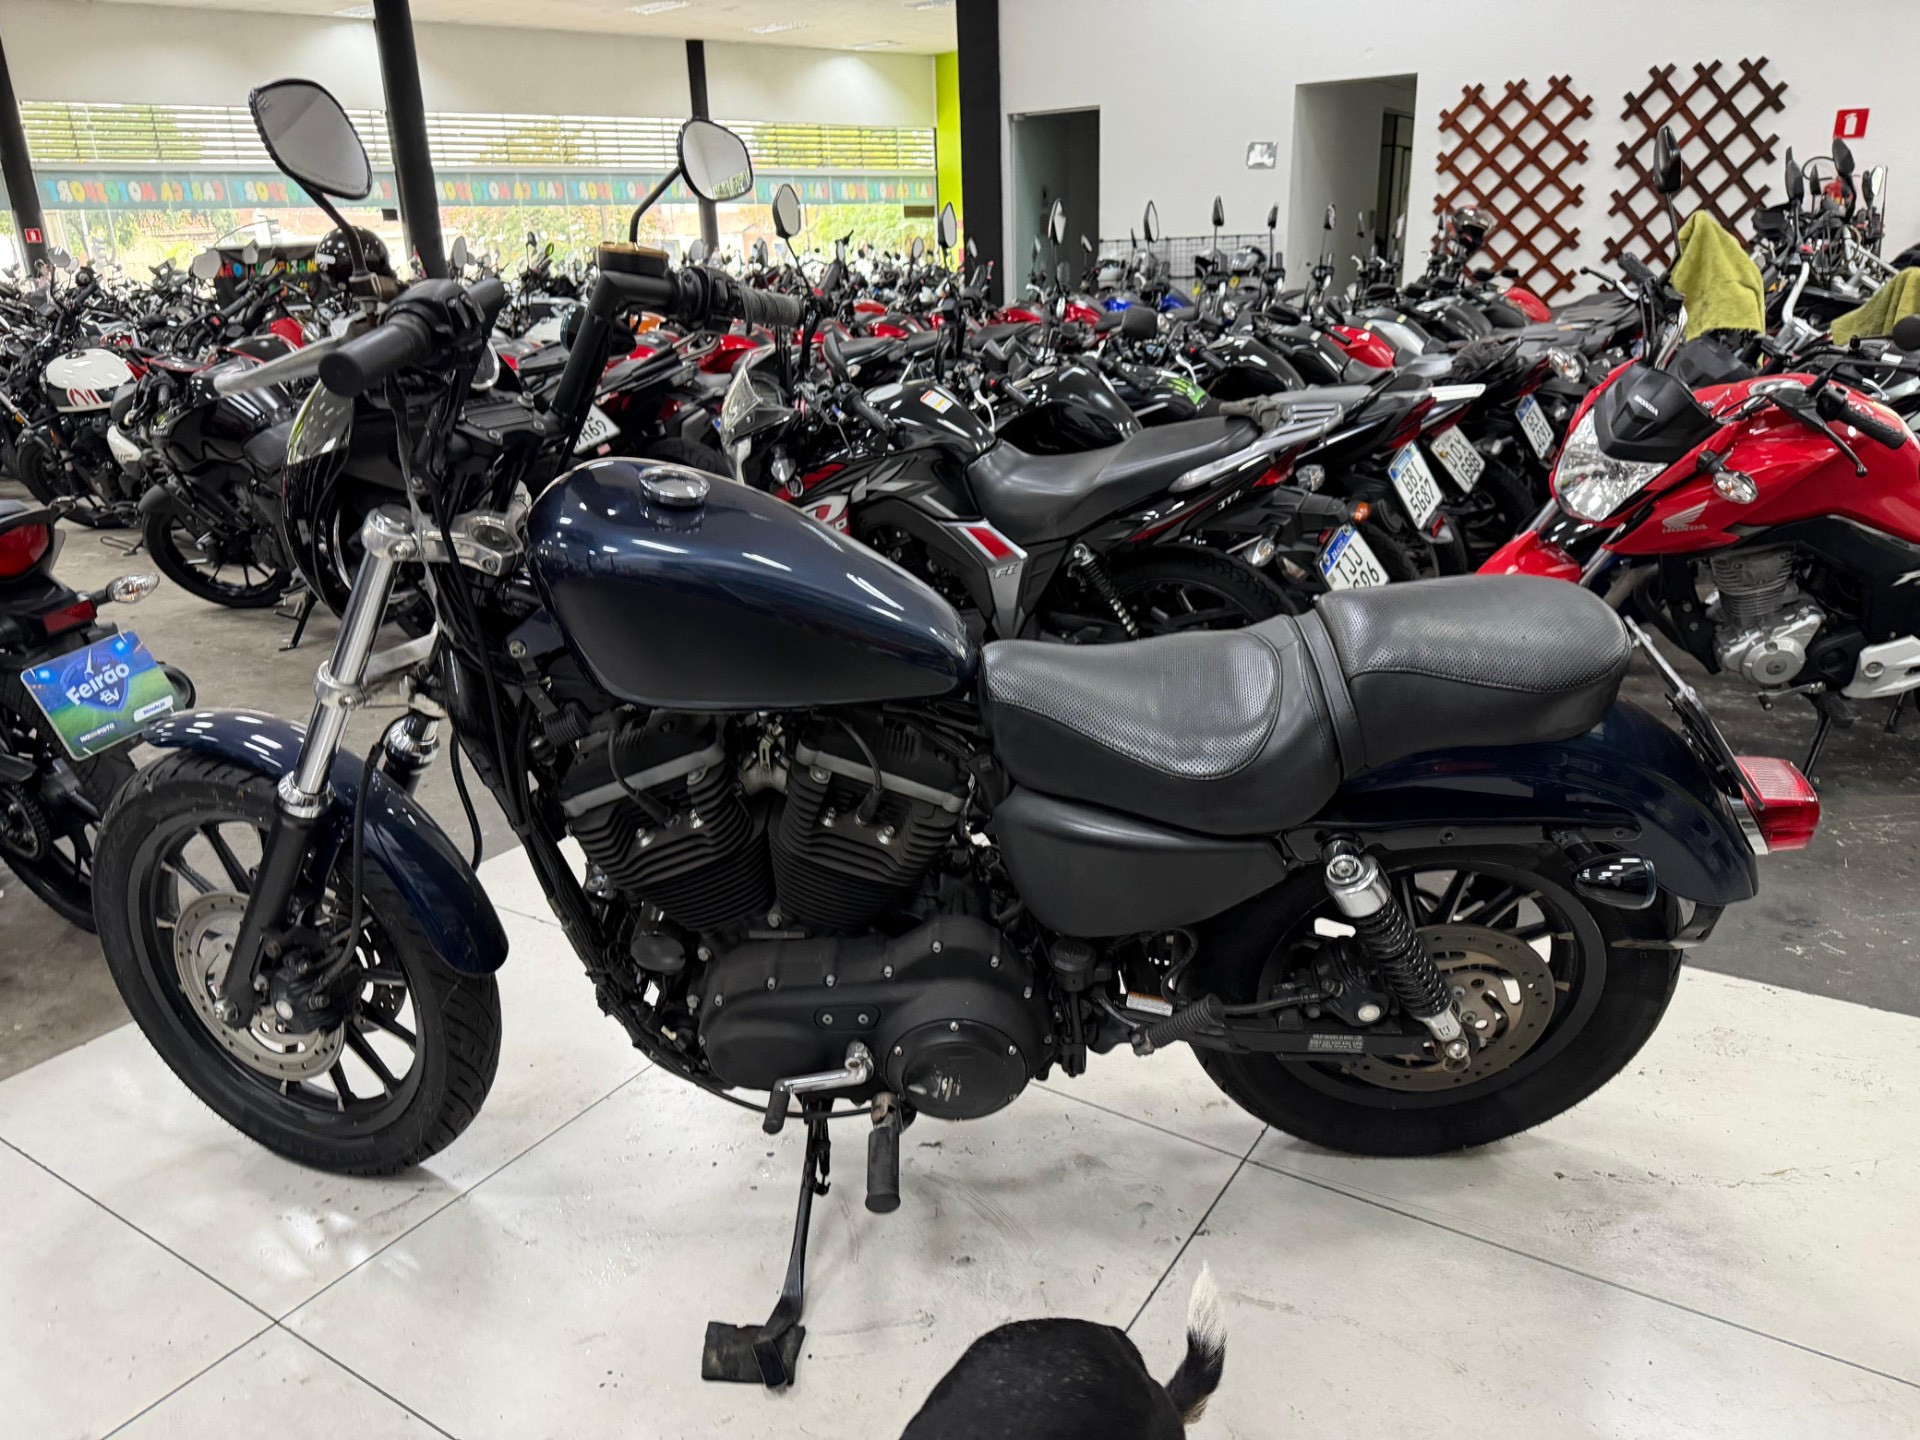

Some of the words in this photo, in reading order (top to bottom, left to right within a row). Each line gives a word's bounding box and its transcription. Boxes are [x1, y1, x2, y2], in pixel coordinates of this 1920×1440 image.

[1410, 478, 1435, 517] 5G87
[1662, 523, 1708, 534] HONDA
[1335, 543, 1363, 584] TJJ
[66, 662, 130, 706] Feirão
